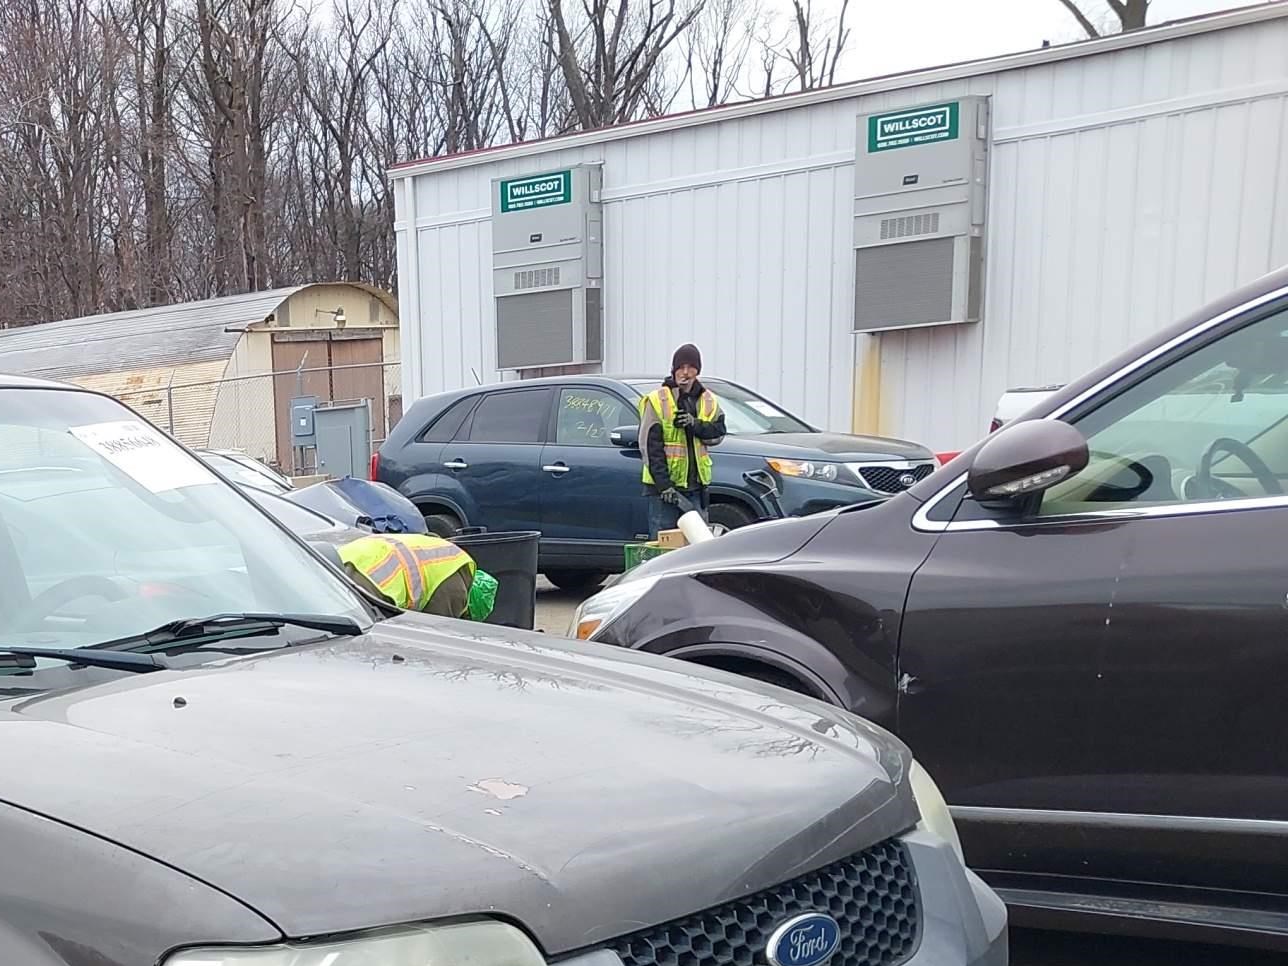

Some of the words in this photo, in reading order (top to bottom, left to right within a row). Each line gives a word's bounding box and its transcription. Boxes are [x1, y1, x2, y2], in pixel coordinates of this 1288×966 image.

[883, 114, 944, 133] WILLSCOT
[512, 181, 560, 196] WILLSCOT
[790, 924, 828, 961] Ford
